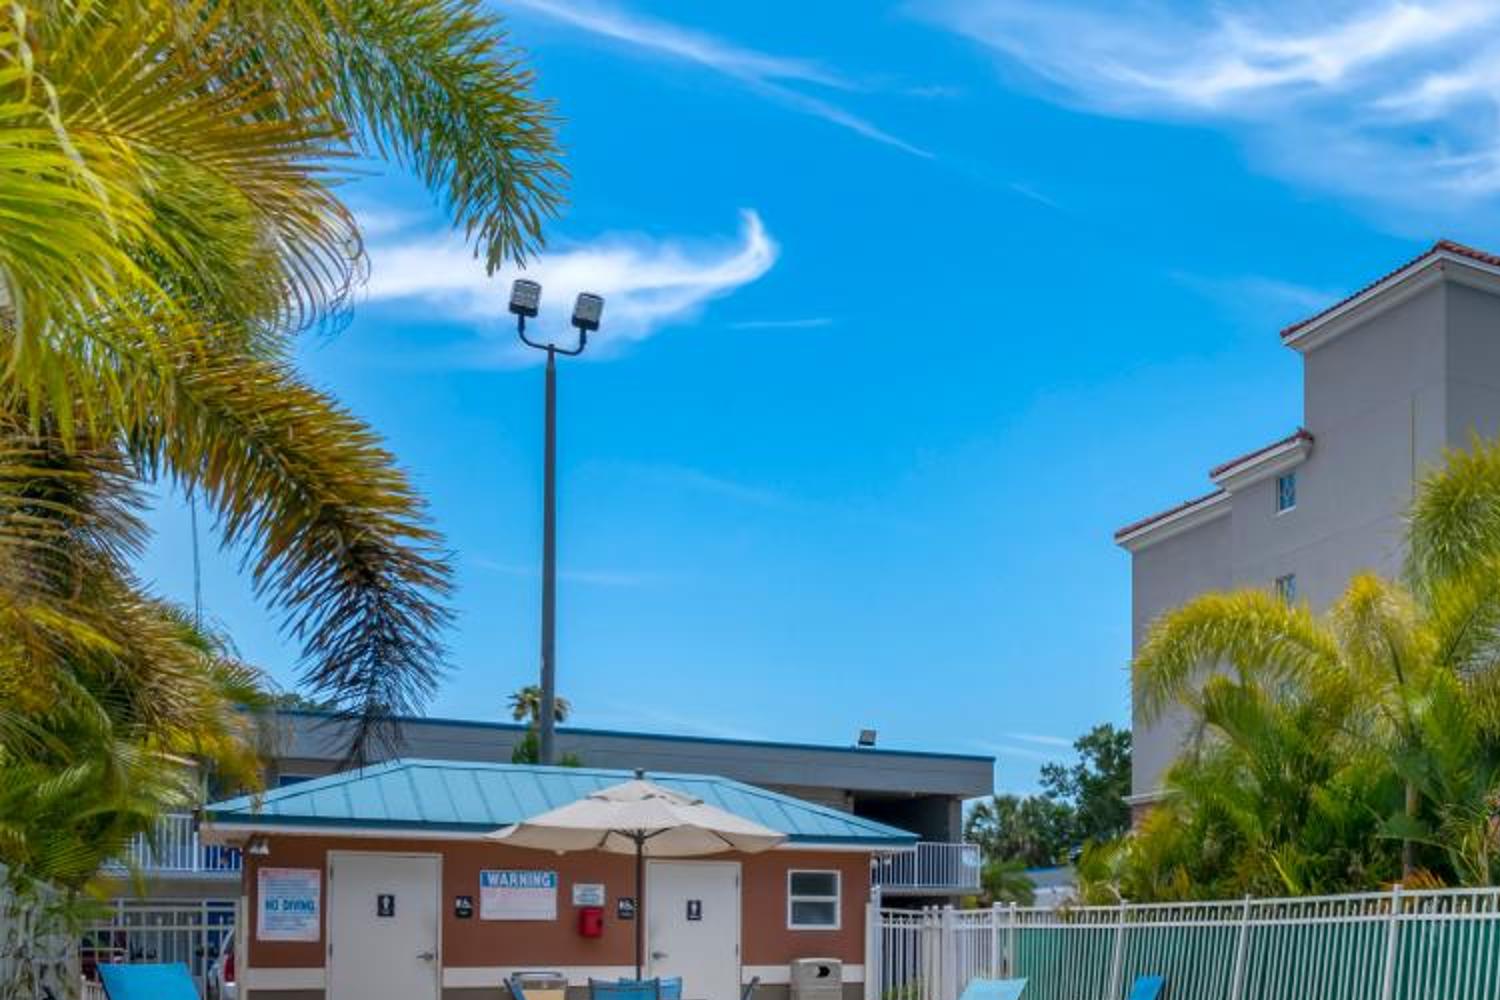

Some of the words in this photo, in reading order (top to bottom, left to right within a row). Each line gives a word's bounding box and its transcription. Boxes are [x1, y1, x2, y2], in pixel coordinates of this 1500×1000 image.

[487, 871, 551, 888] WARNING
[265, 899, 279, 911] NO
[282, 899, 315, 912] DIVING
